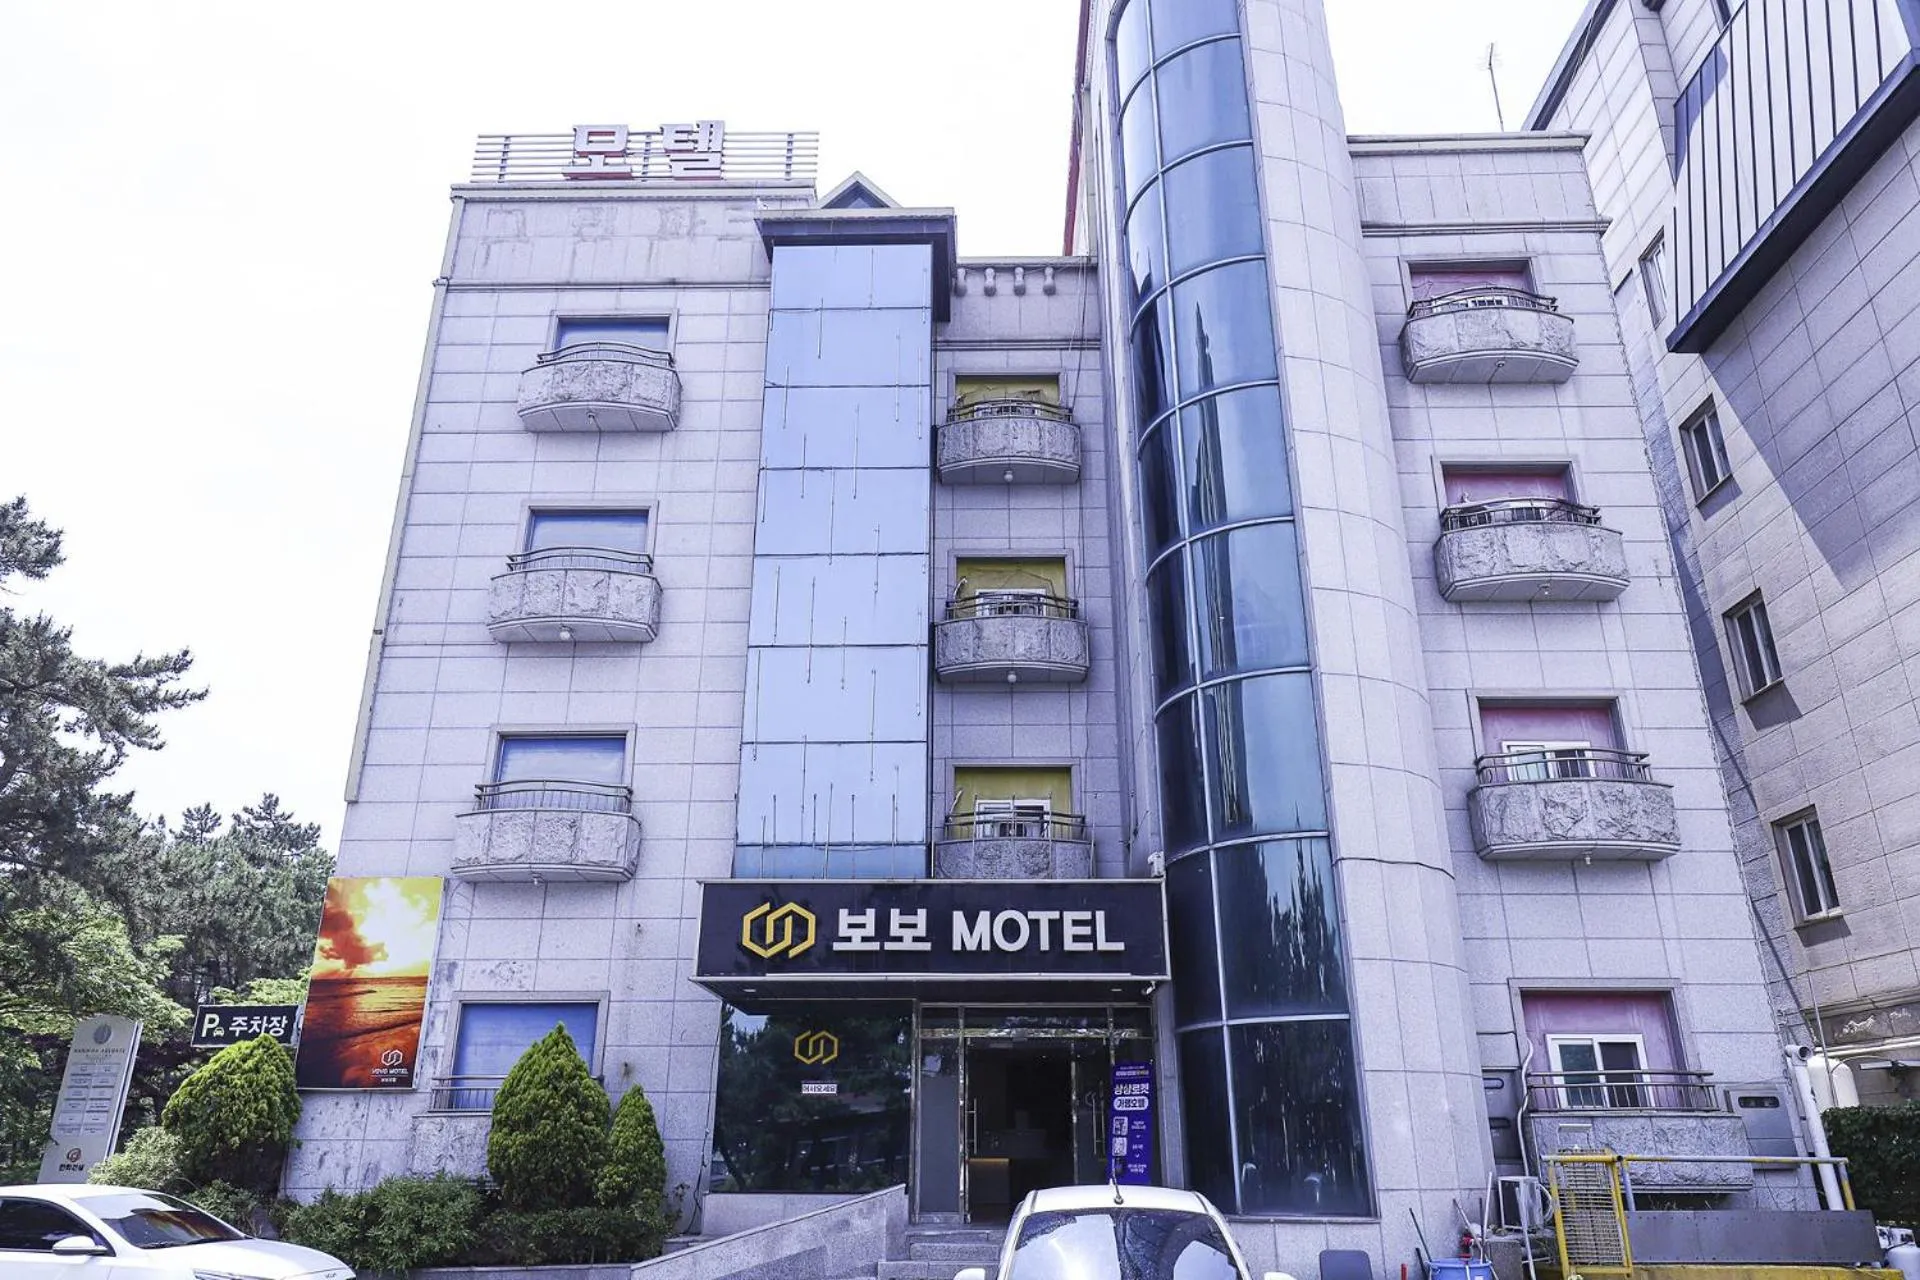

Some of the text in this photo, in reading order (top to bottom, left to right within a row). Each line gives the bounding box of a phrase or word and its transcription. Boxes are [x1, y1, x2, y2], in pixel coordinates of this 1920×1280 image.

[561, 119, 726, 180] 모텔
[833, 907, 1126, 953] 보보 MOTEL
[201, 1013, 289, 1038] P 주차장
